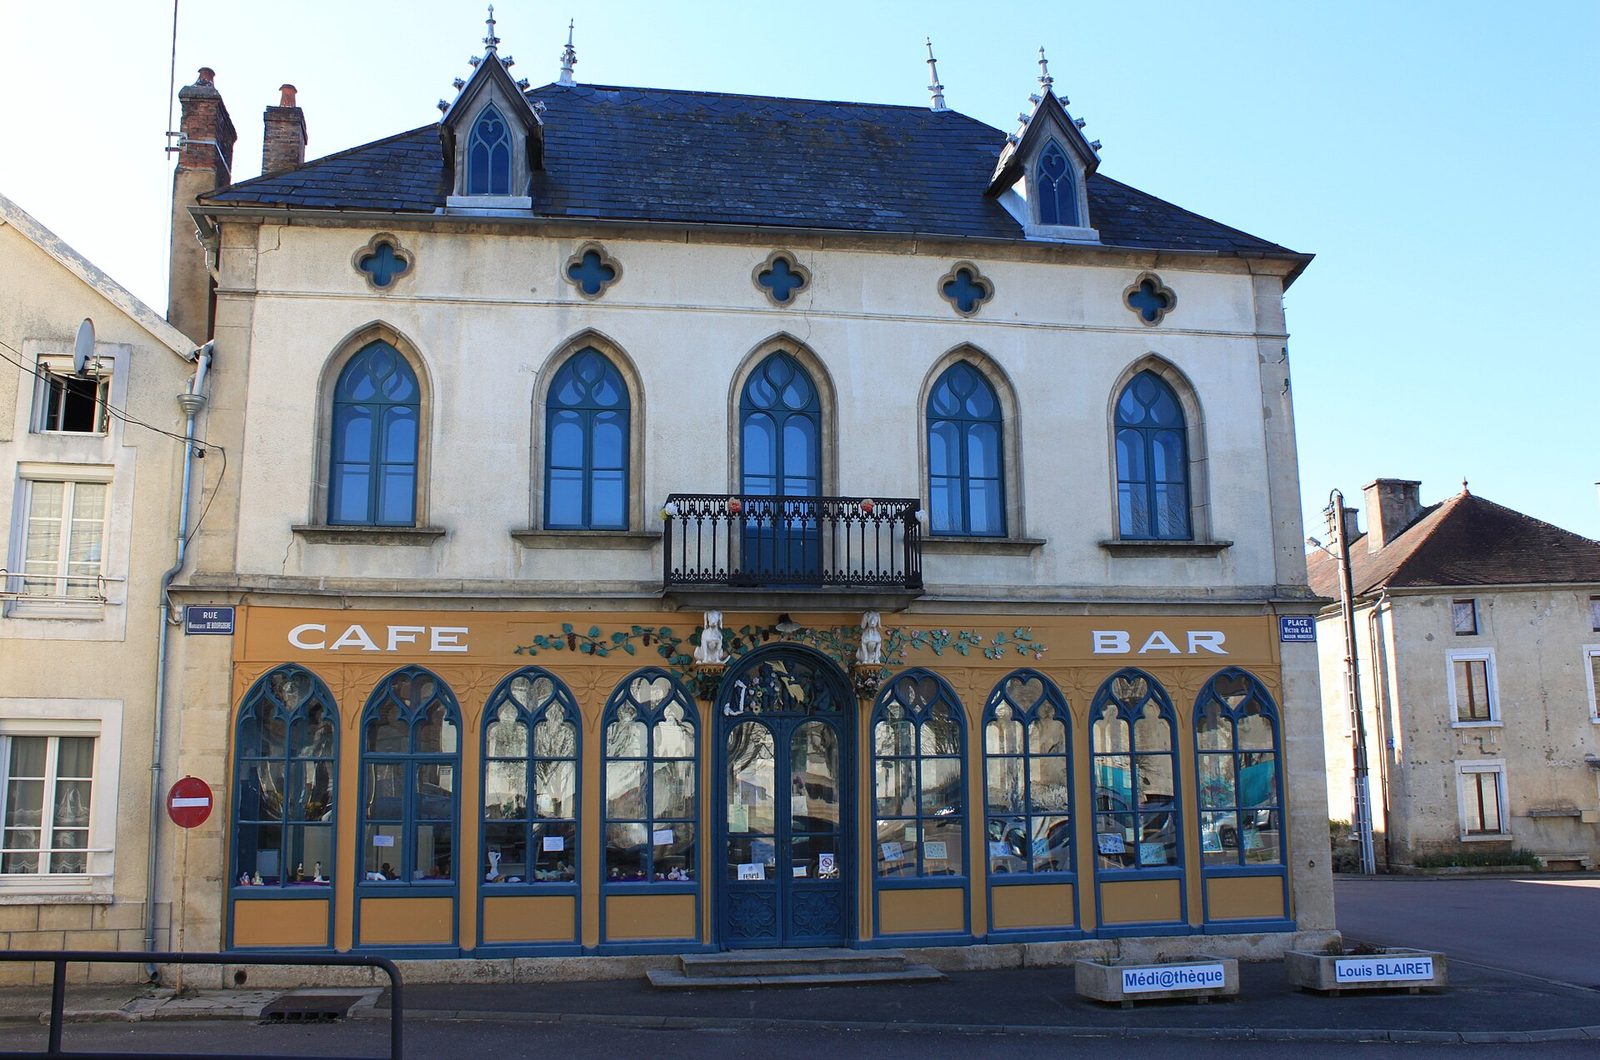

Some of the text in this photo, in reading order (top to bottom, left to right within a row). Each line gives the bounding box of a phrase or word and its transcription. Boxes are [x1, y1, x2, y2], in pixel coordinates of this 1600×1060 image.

[203, 611, 218, 619] RUE
[1287, 619, 1308, 627] PLACE
[287, 623, 469, 652] CAFE
[1091, 630, 1230, 654] BAR
[1338, 962, 1431, 977] Louis BLAIRET
[1125, 969, 1223, 988] Médi@thèque
